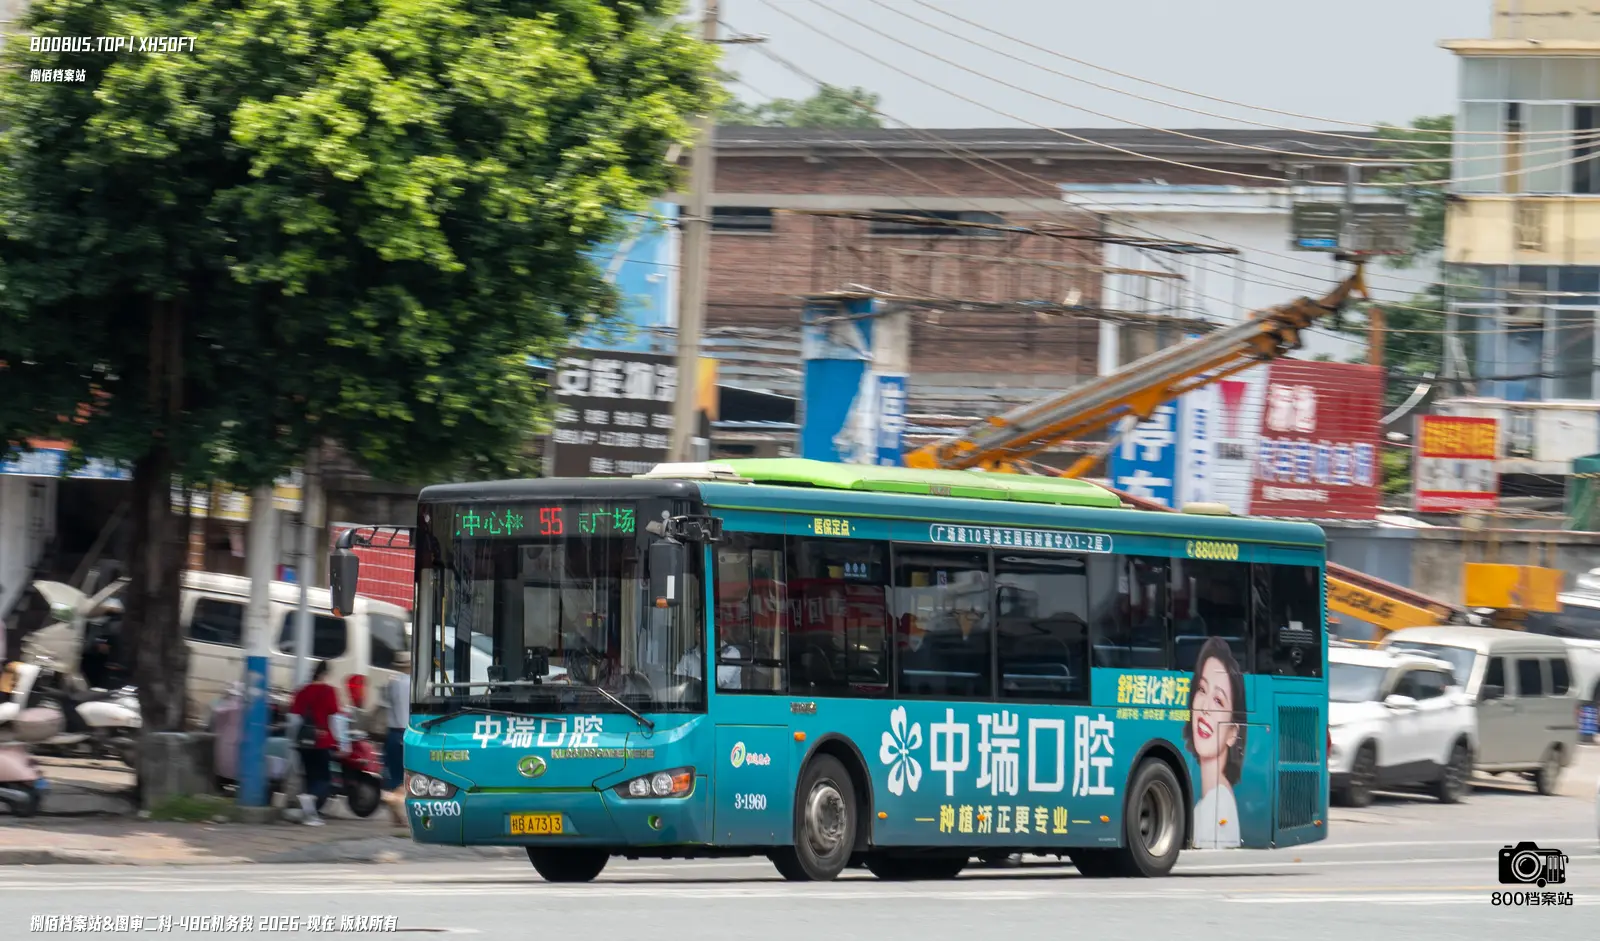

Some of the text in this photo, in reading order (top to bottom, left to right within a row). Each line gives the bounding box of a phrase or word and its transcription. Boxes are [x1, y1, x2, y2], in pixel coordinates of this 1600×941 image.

[539, 507, 563, 535] 55
[814, 518, 850, 536] 医保定点
[1117, 674, 1191, 706] 舒适化种牙
[472, 715, 603, 748] 中瑞口腔
[930, 708, 1115, 797] 中瑞口腔
[413, 801, 461, 817] 3-1960
[939, 803, 1068, 834] 种植矫正更专业
